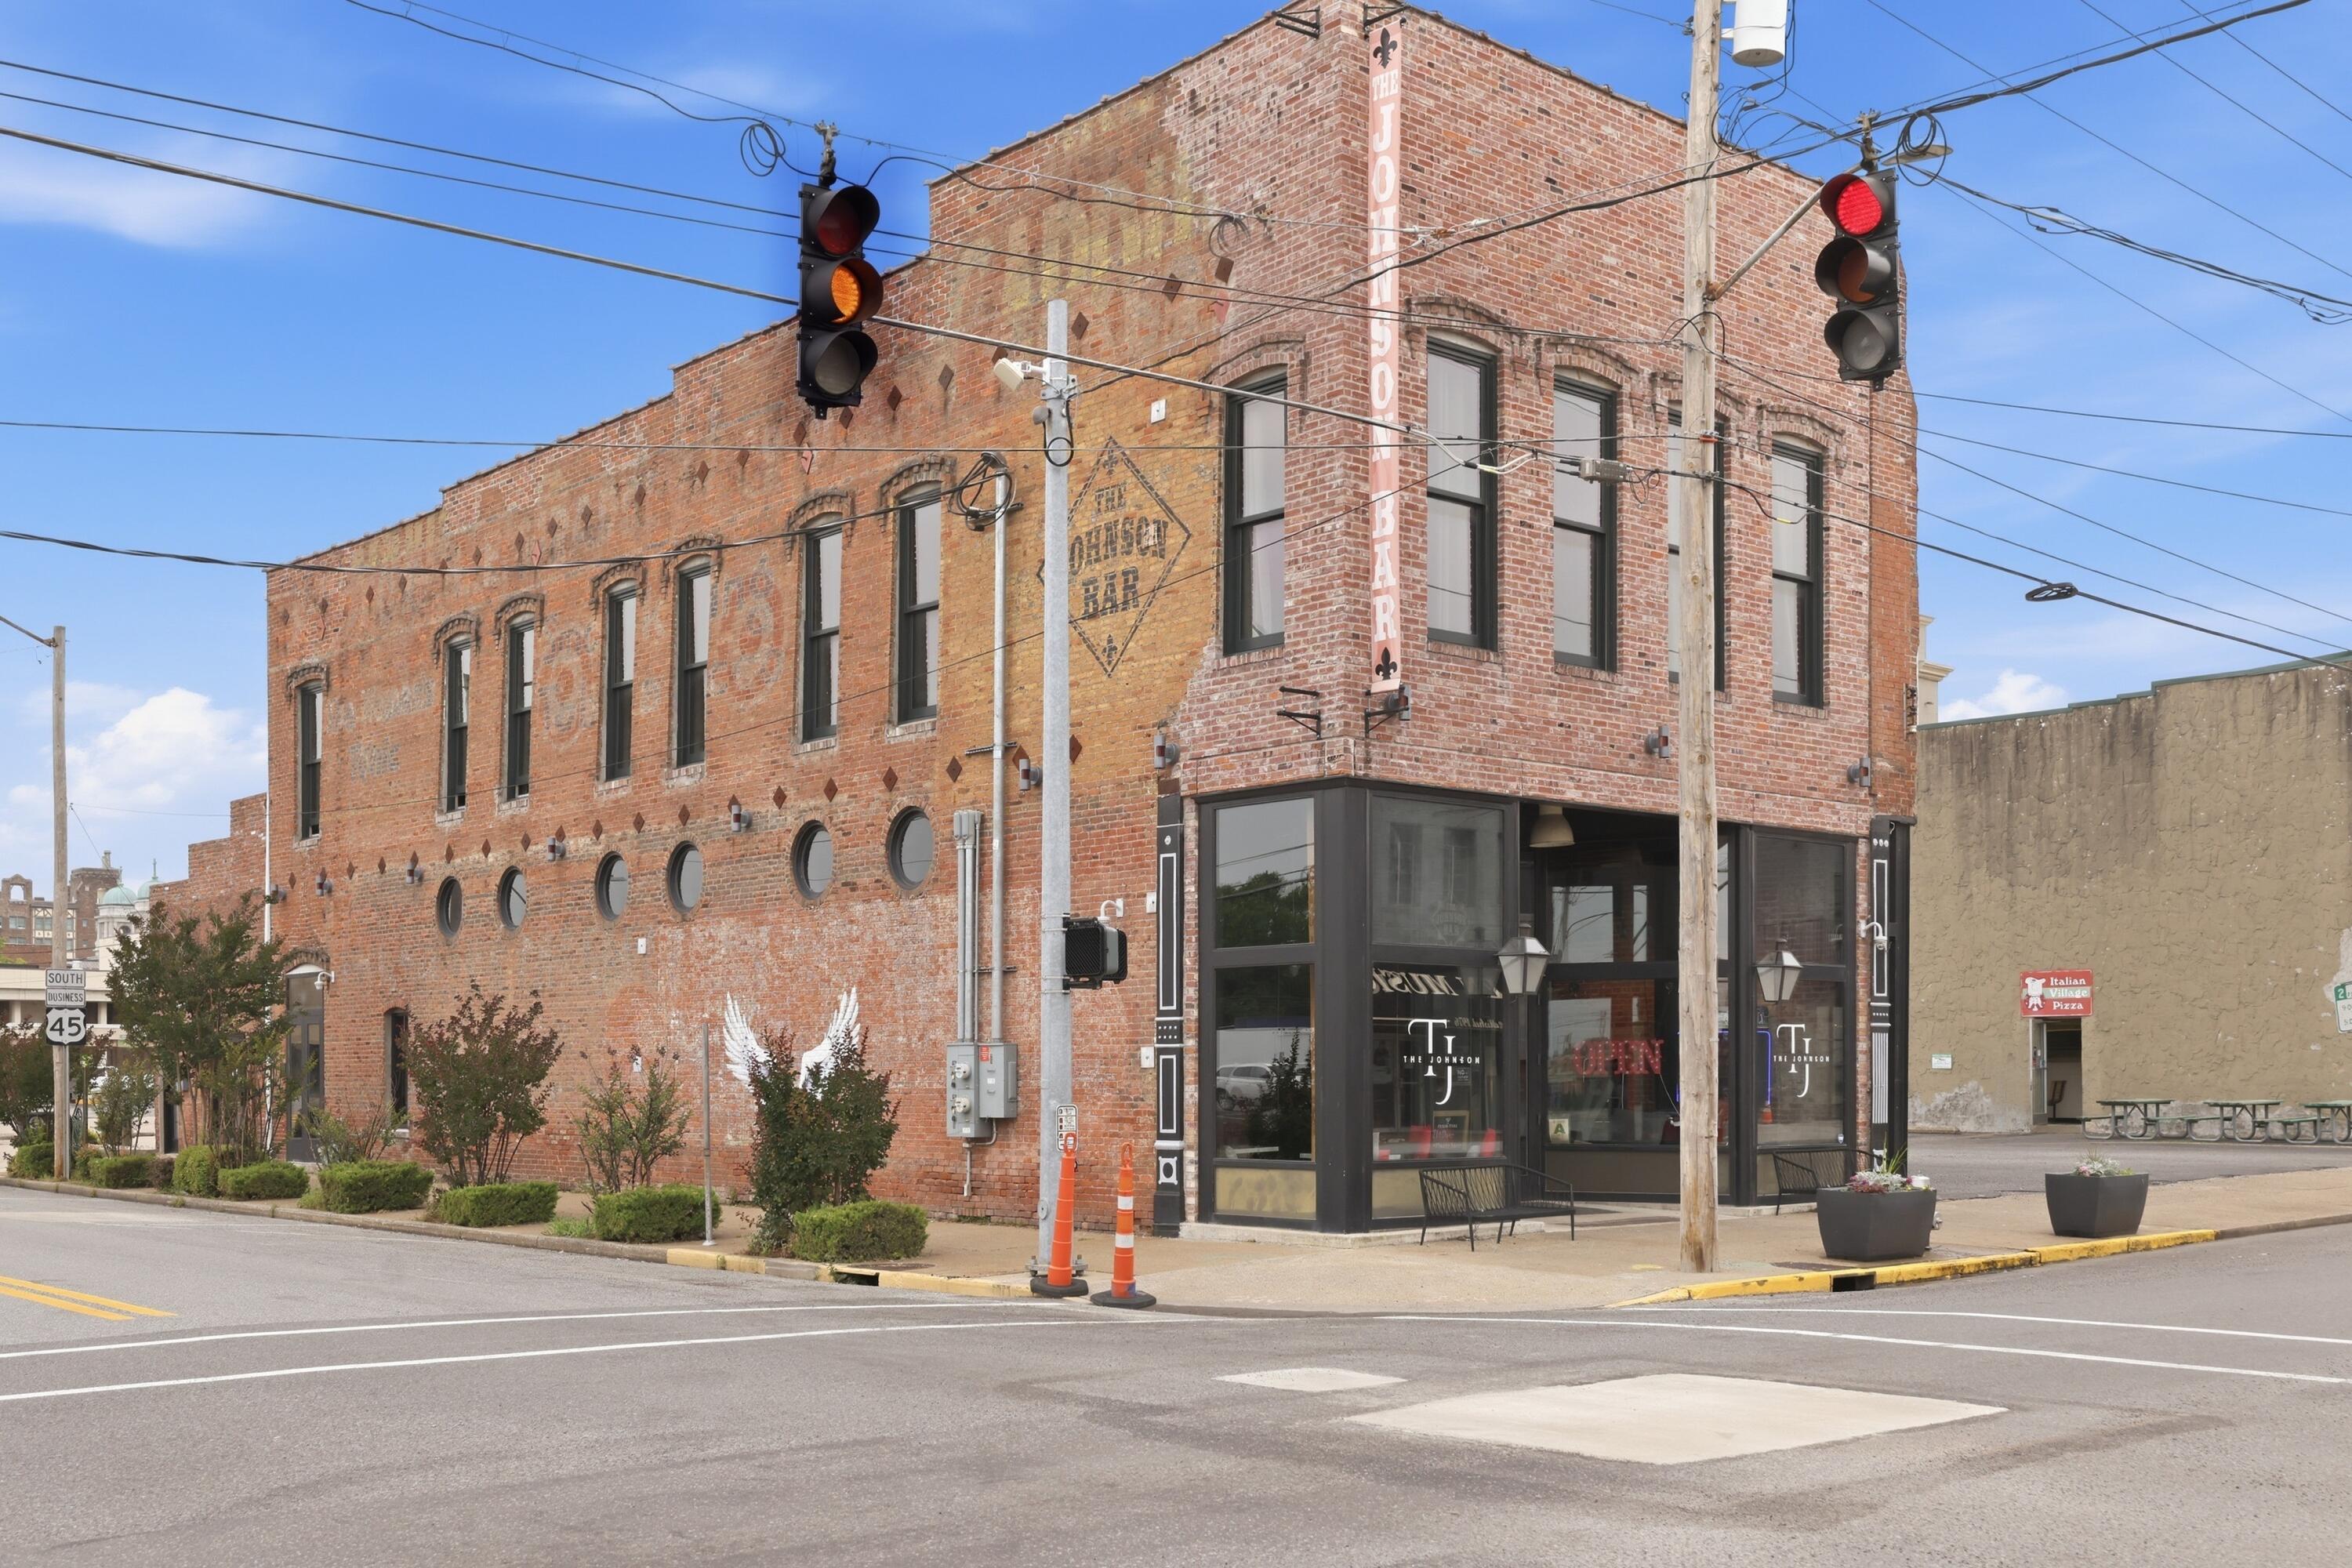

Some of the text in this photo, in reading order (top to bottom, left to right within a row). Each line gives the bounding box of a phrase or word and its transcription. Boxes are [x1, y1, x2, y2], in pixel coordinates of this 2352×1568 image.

[1370, 69, 1398, 641] THE JOHNSON BAR
[1094, 482, 1126, 515] THE
[1069, 516, 1168, 576] OHNSON
[1081, 566, 1139, 619] BAR
[48, 973, 83, 984] SOUTH
[2050, 977, 2086, 985] Italian
[48, 992, 83, 1002] BUSINESS
[2049, 989, 2088, 999] Village
[2053, 1001, 2084, 1010] Pizza
[49, 1017, 82, 1036] 45
[1403, 1055, 1480, 1065] THE JOHNSON
[1572, 1039, 1664, 1075] OPEN
[1554, 1123, 1566, 1134] A
